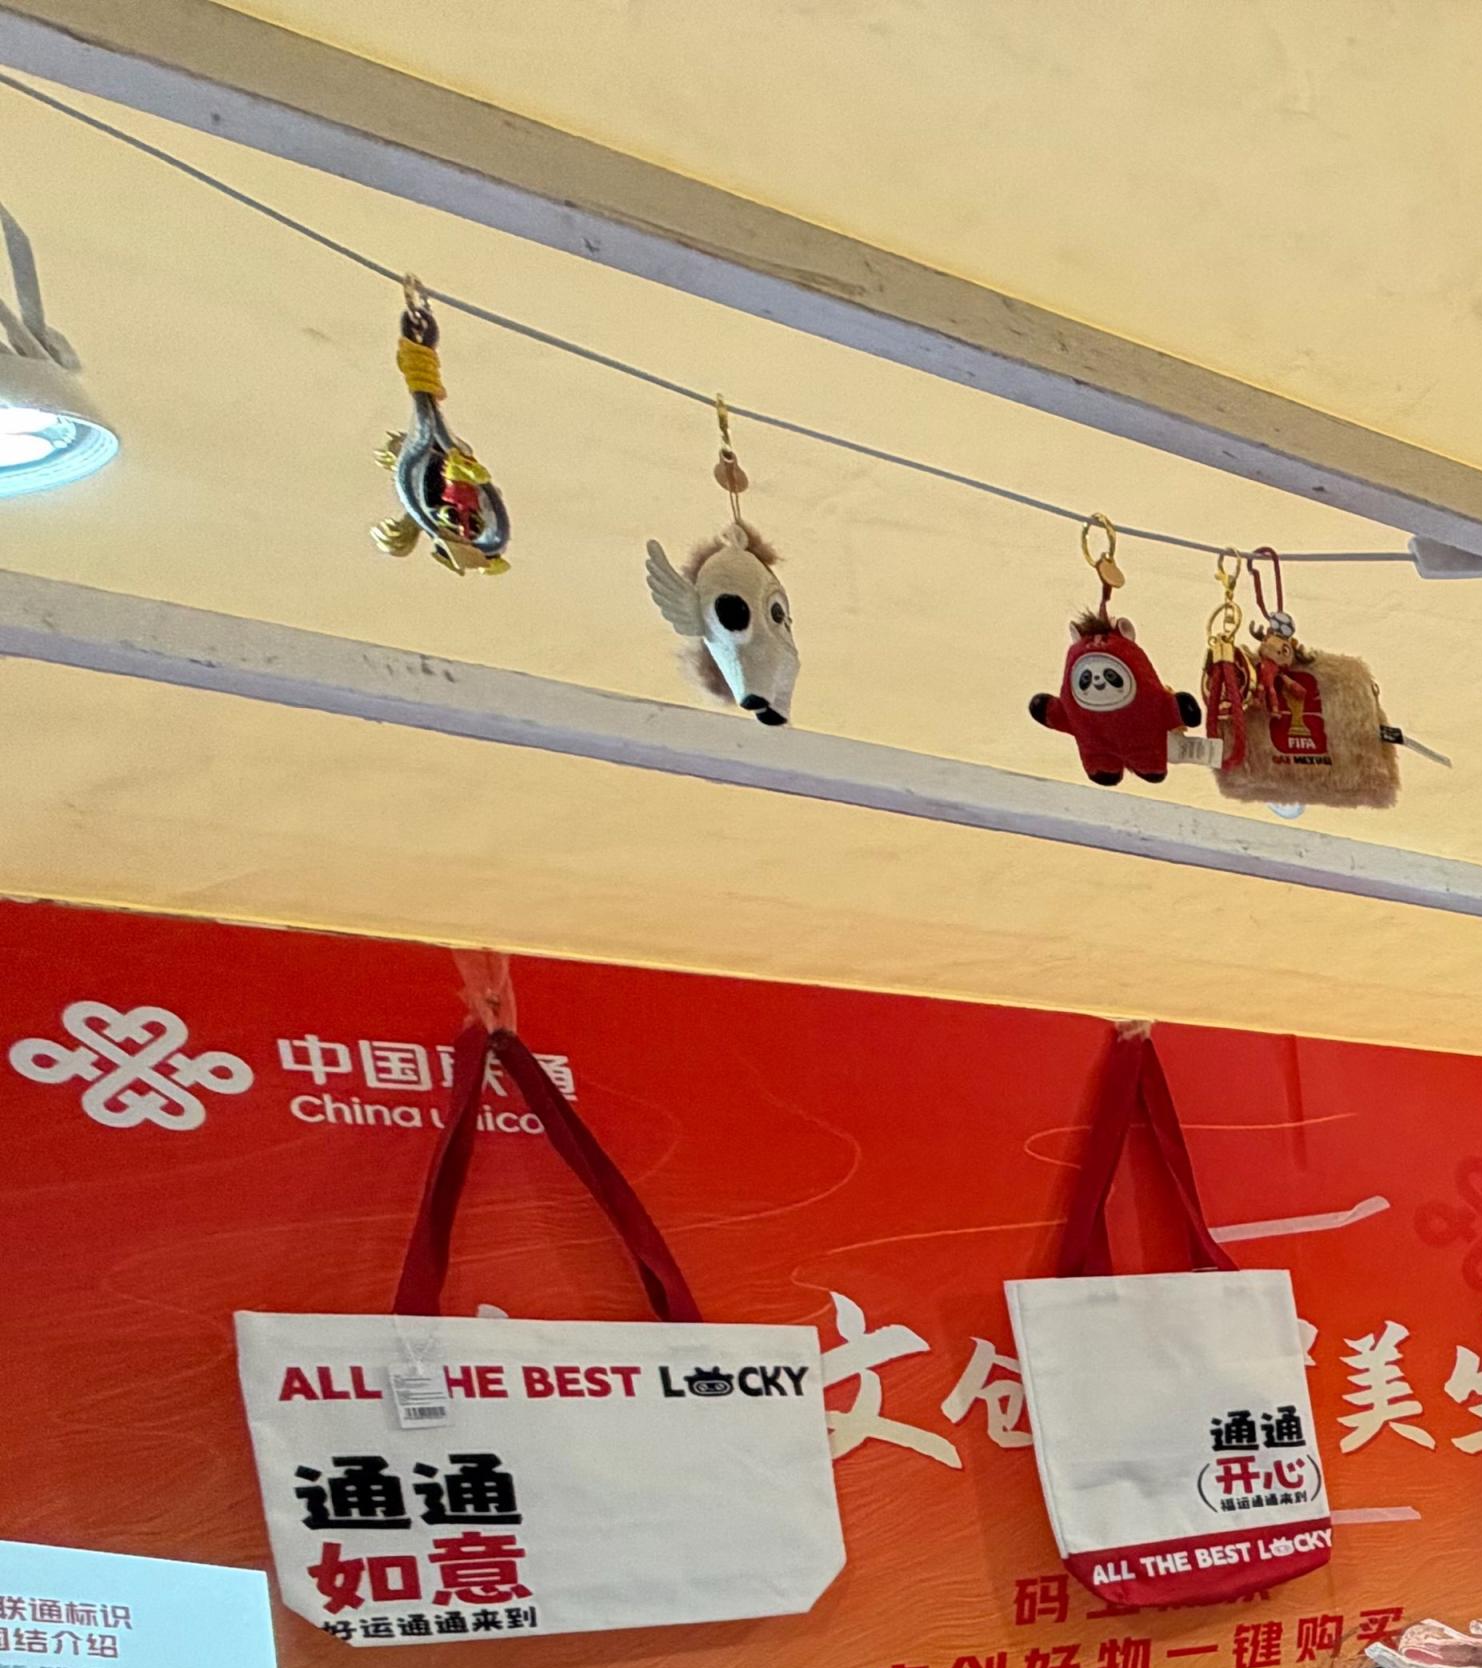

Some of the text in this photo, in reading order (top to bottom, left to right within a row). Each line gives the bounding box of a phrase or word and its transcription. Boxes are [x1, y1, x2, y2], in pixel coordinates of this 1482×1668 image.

[1287, 736, 1317, 750] FIFA
[290, 1094, 422, 1128] China
[278, 1365, 383, 1401] ALL
[521, 1365, 642, 1398] BEST
[1209, 1404, 1307, 1452] 通通
[294, 1453, 523, 1530] 通通
[306, 1530, 534, 1615] 如意
[1092, 1561, 1136, 1586] ALL
[1140, 1550, 1192, 1579] THE
[1194, 1541, 1251, 1569] BEST
[0, 1595, 133, 1630] 联通标识
[321, 1606, 538, 1641] 好运通通来到
